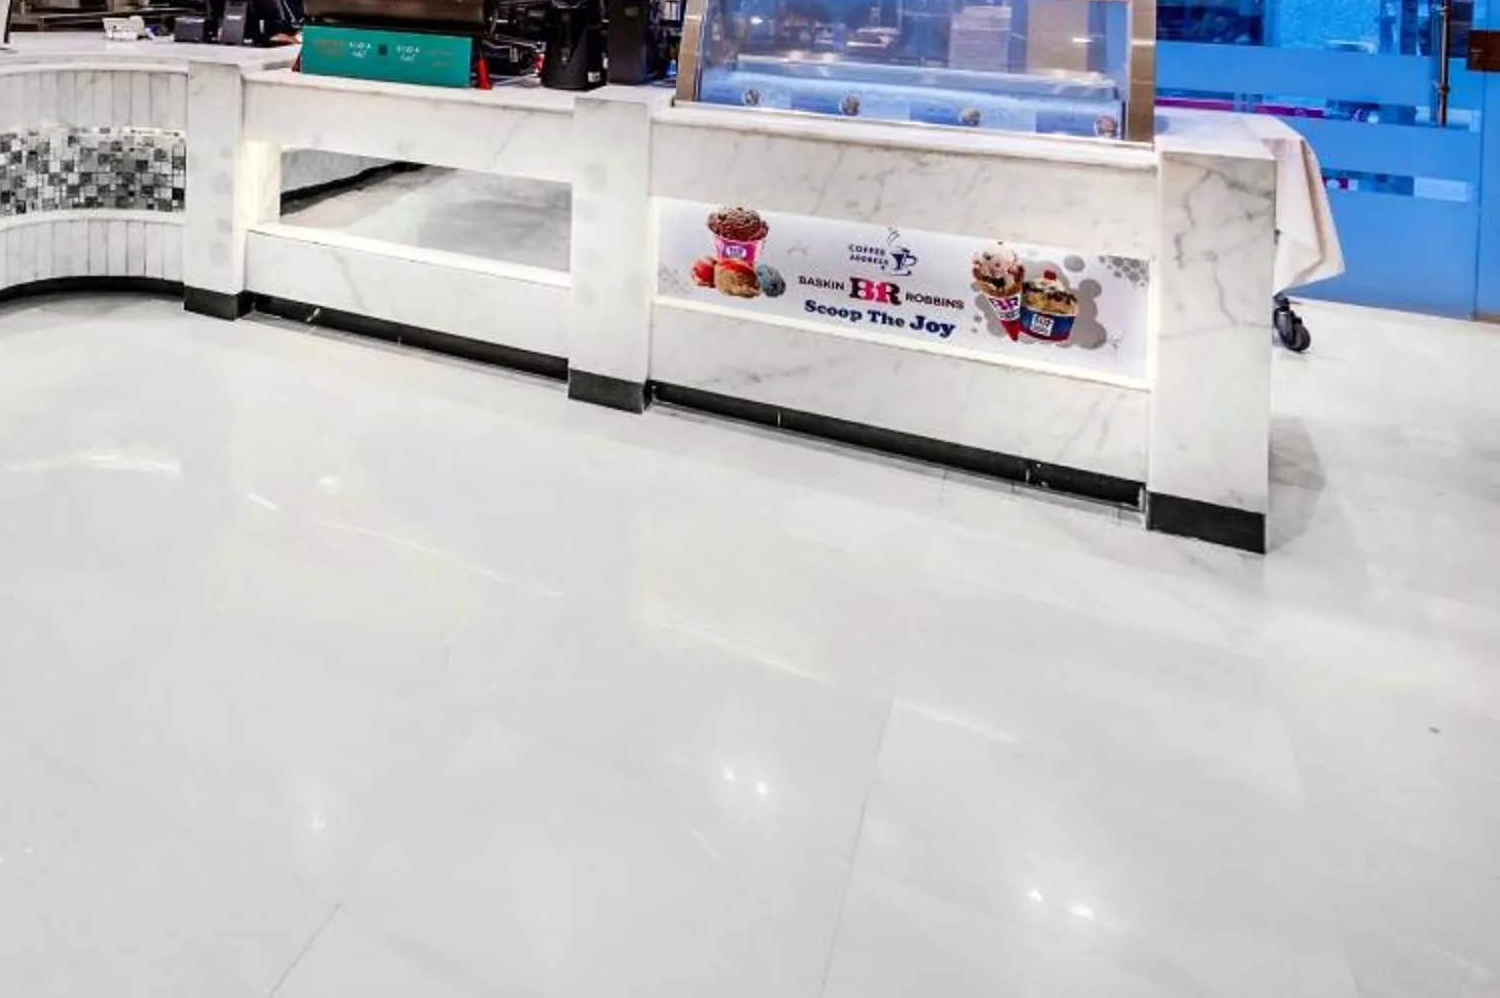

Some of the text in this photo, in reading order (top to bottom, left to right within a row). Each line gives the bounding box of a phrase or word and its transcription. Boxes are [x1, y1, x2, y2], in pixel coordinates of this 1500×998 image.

[848, 243, 885, 256] COFFEE
[799, 275, 845, 291] BASKIN
[849, 276, 902, 306] BR
[905, 291, 965, 310] ROBBINS
[804, 299, 957, 339] Scoop The Joy
